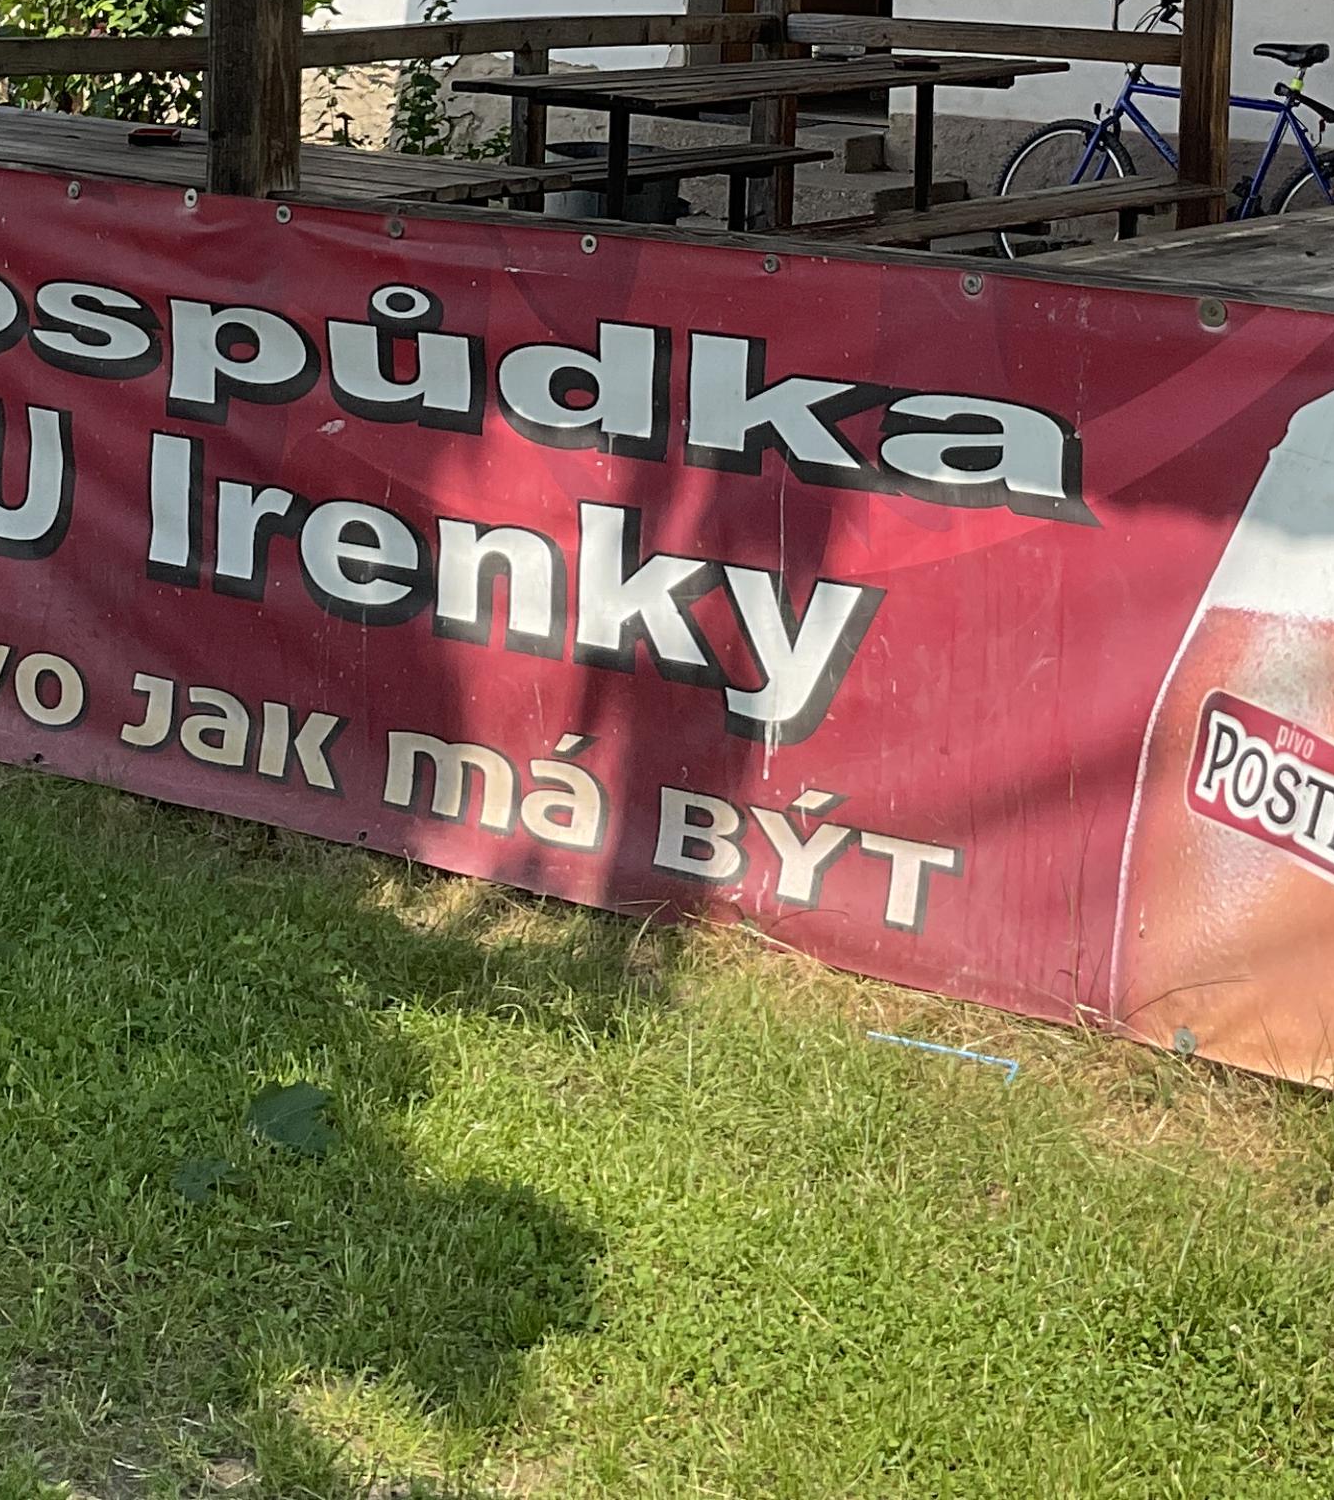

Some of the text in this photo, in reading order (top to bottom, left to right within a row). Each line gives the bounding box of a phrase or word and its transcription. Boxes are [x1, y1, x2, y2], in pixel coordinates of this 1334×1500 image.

[147, 432, 865, 723] Irenky
[382, 730, 603, 849] má
[652, 785, 959, 928] BÝT
[1274, 722, 1316, 761] pivo
